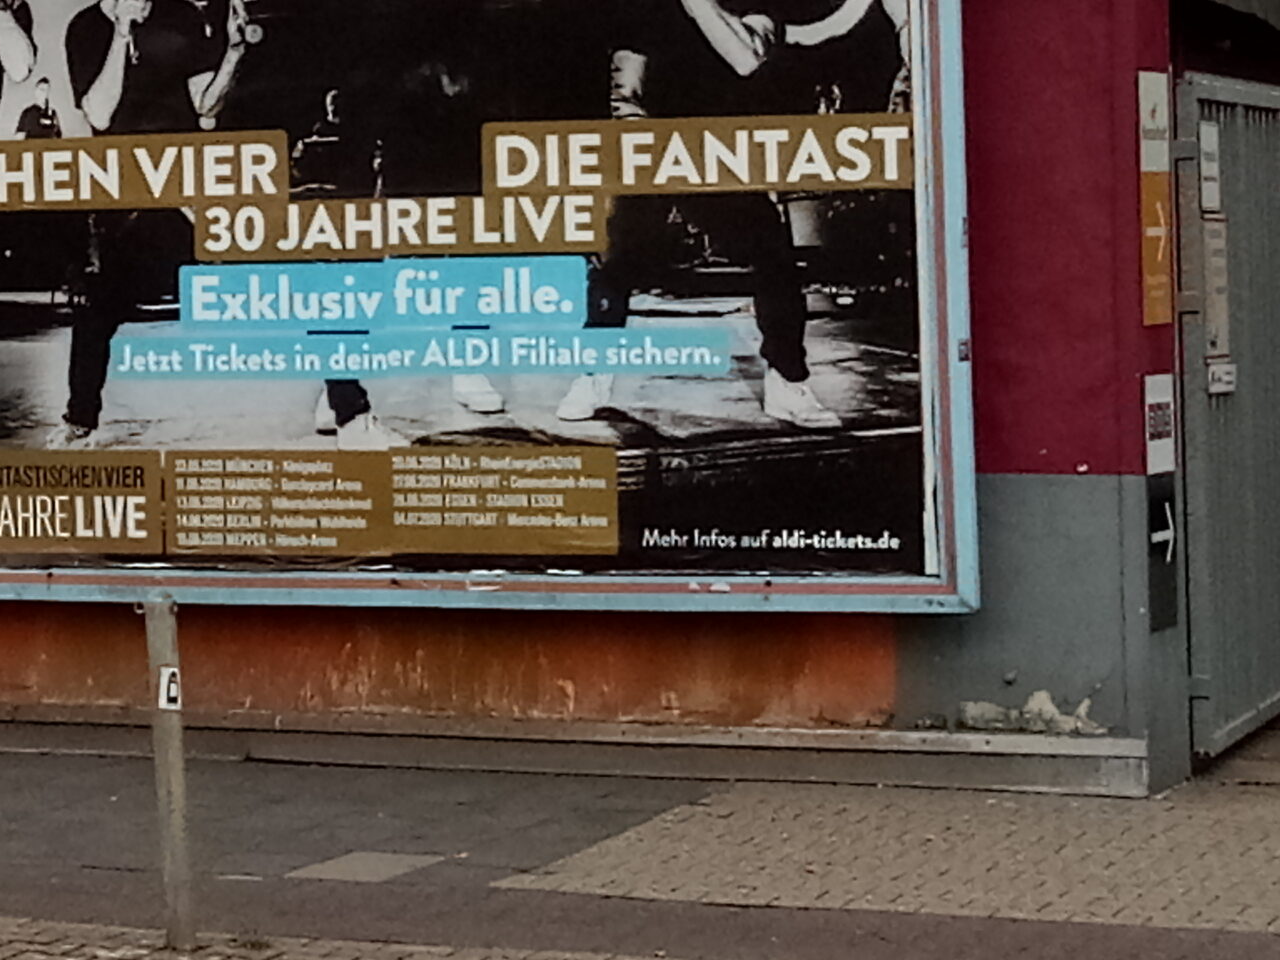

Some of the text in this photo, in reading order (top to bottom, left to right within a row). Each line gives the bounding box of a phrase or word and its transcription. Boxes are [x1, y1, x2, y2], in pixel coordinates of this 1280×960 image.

[132, 143, 278, 199] VIER
[495, 126, 910, 188] DIE FANTAST
[203, 195, 595, 253] 30 JAHRE LIVE
[191, 267, 575, 321] Exklusiv für alle.
[116, 337, 721, 372] Jetzt Tickets in deiner ALDI Filiale sichern.
[75, 495, 147, 538] LIVE
[642, 527, 901, 550] Mehr Infos auf aldi-tickets.de
